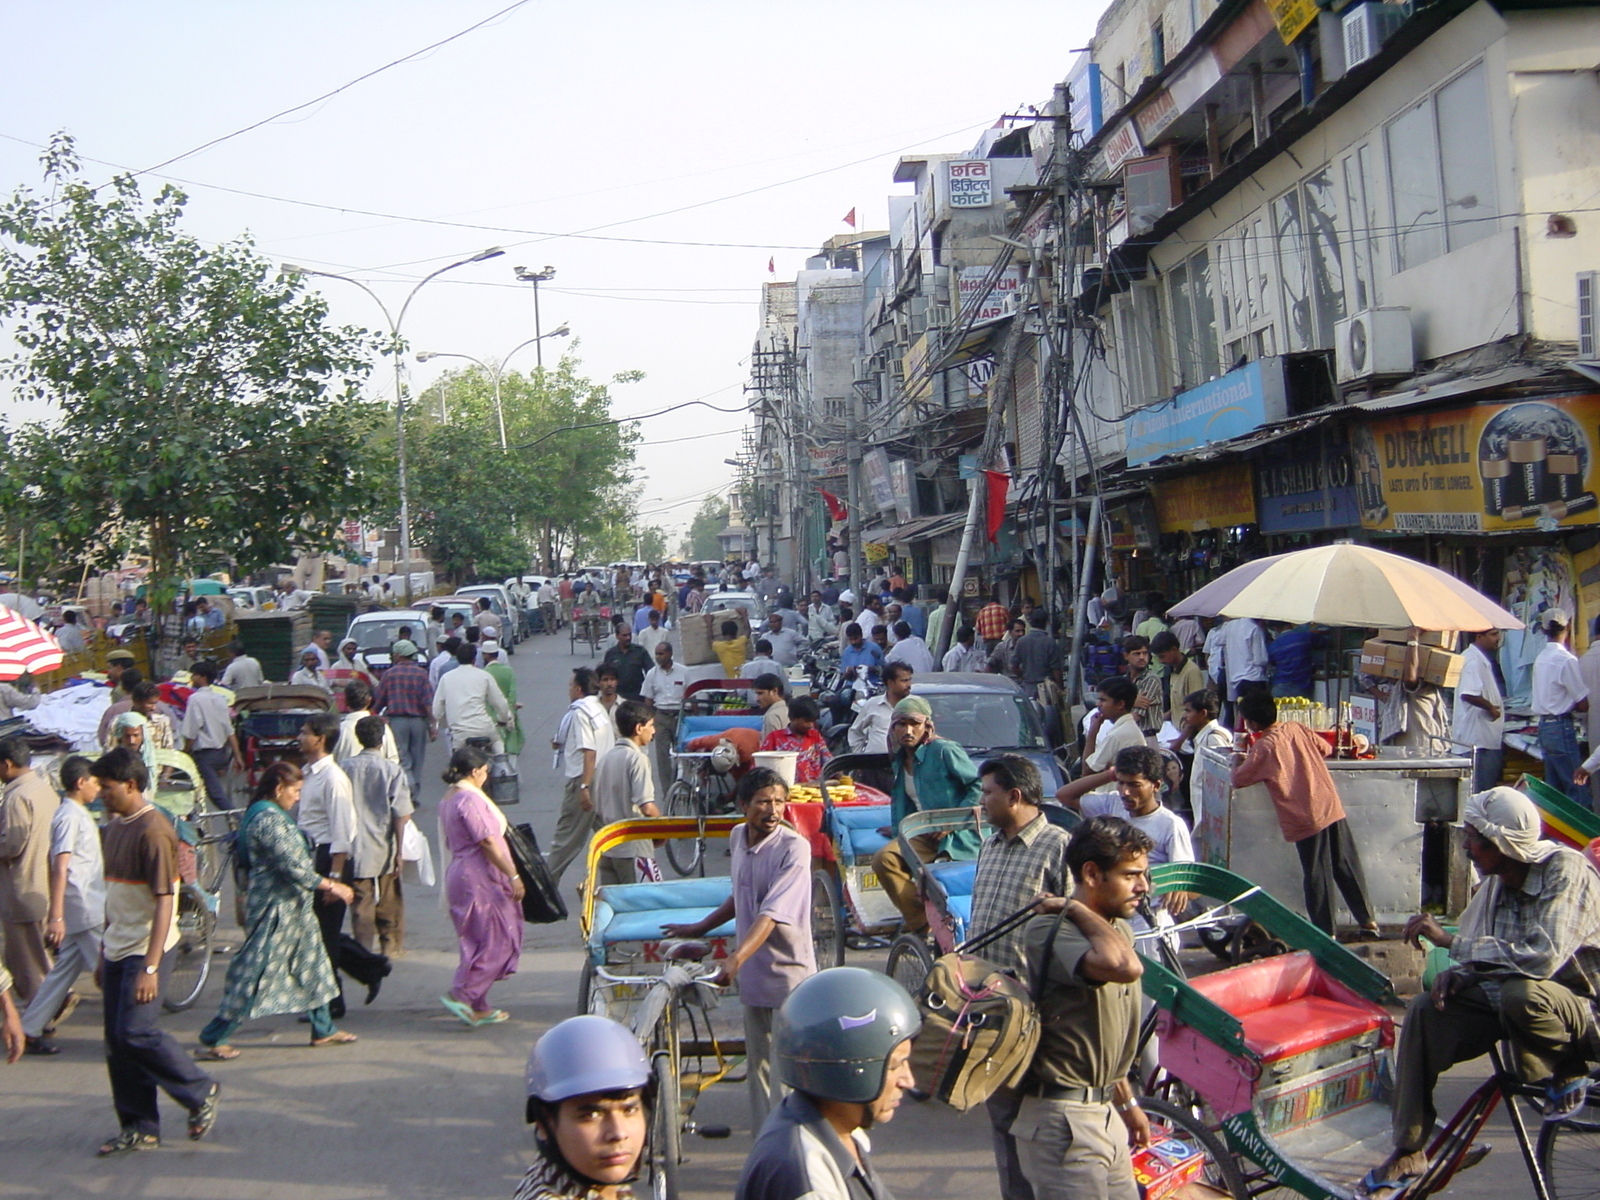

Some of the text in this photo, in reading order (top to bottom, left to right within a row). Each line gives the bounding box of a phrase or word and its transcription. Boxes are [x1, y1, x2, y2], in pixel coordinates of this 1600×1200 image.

[1106, 128, 1133, 165] GINNI
[950, 178, 990, 192] डिजिटल
[951, 191, 989, 205] फोटो
[959, 279, 1017, 291] MAUM
[1169, 372, 1253, 423] International
[1384, 423, 1470, 469] DURACELL
[1260, 470, 1269, 499] K
[1272, 468, 1279, 497] L
[1282, 462, 1313, 496] SHAH
[1329, 455, 1348, 488] CO
[1422, 471, 1430, 491] 6
[1525, 463, 1536, 502] DURACELL
